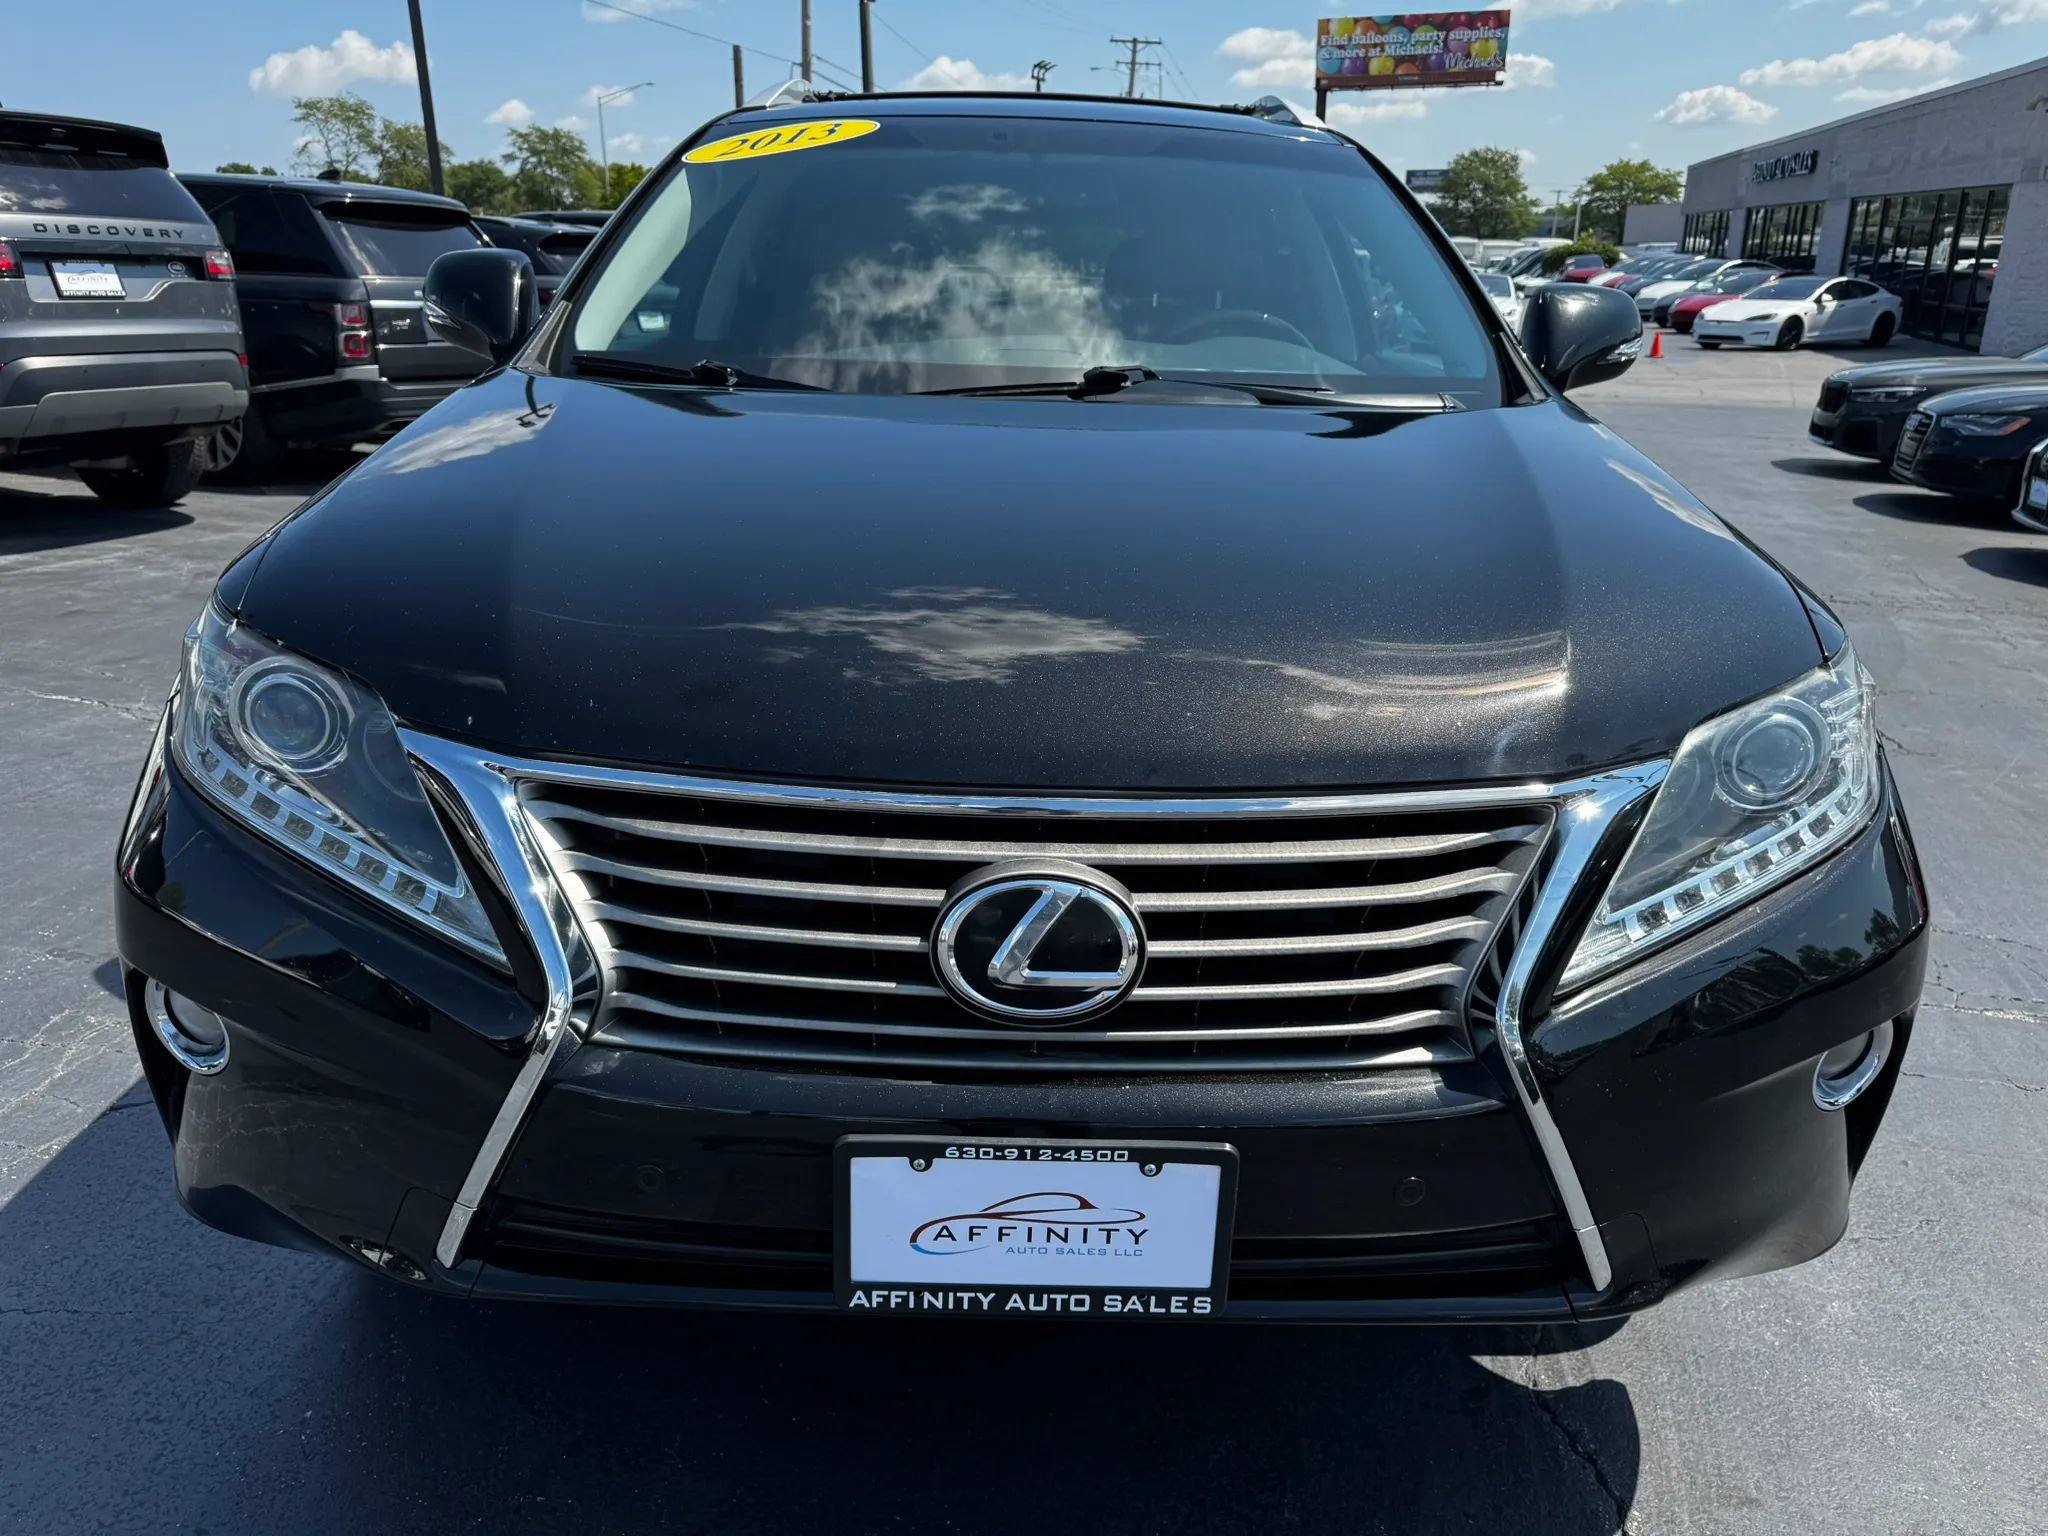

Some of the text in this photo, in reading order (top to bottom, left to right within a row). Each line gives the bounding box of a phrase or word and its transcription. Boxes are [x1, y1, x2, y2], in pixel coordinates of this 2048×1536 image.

[1320, 26, 1505, 46] Find balloons, party supplies,
[1320, 41, 1444, 60] & more at Michaels!
[1445, 51, 1504, 70] Michaels
[715, 123, 843, 158] 2013
[32, 222, 185, 239] DISCOVERY
[945, 1146, 1129, 1162] 630-912-4500
[932, 1225, 1149, 1245] AFFINITY
[1005, 1246, 1144, 1257] AUTO SALES LLC
[849, 1290, 1212, 1314] AFFINITY AUTO SALES
